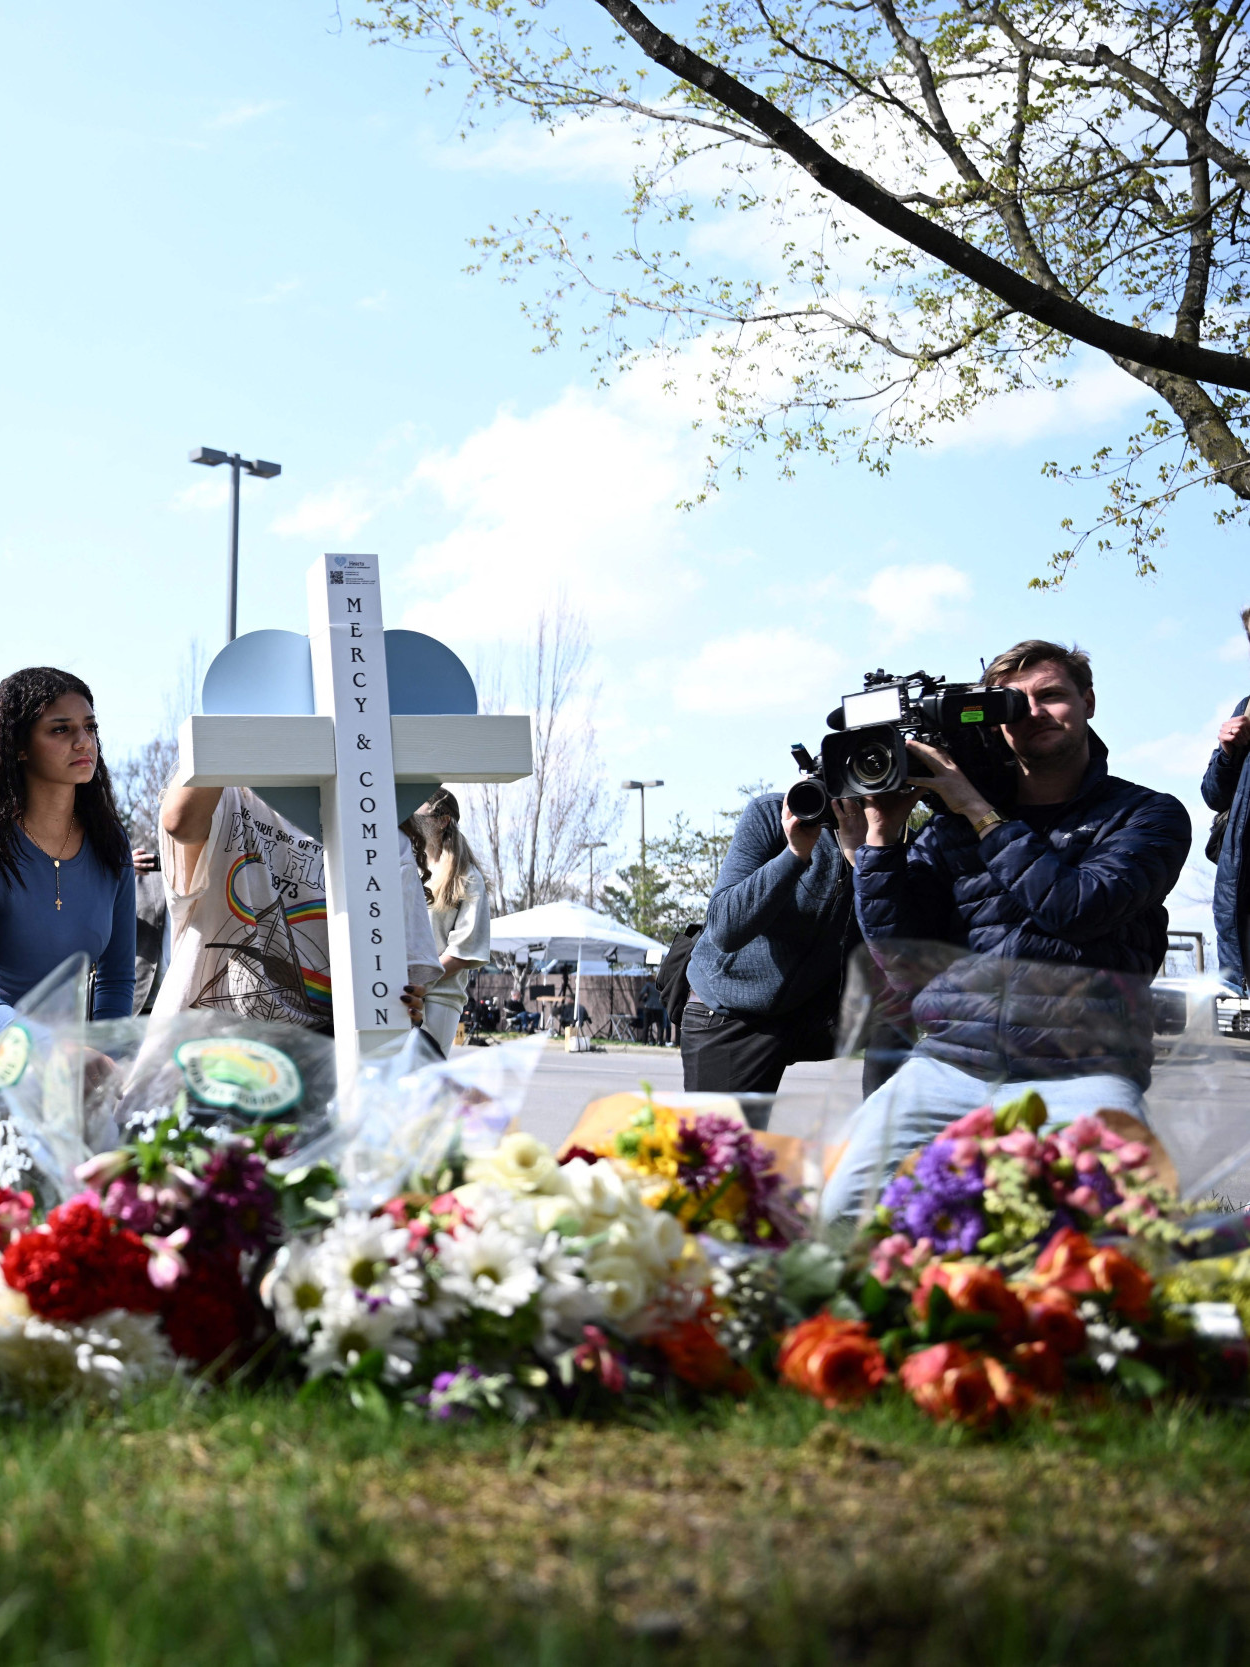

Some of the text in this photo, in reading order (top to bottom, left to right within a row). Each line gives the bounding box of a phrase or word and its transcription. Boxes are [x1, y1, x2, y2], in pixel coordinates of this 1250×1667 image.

[346, 597, 367, 713] MERCY
[356, 733, 372, 751] &
[253, 818, 274, 837] ARK
[271, 872, 299, 899] 1973
[359, 771, 389, 1025] COMPASSION
